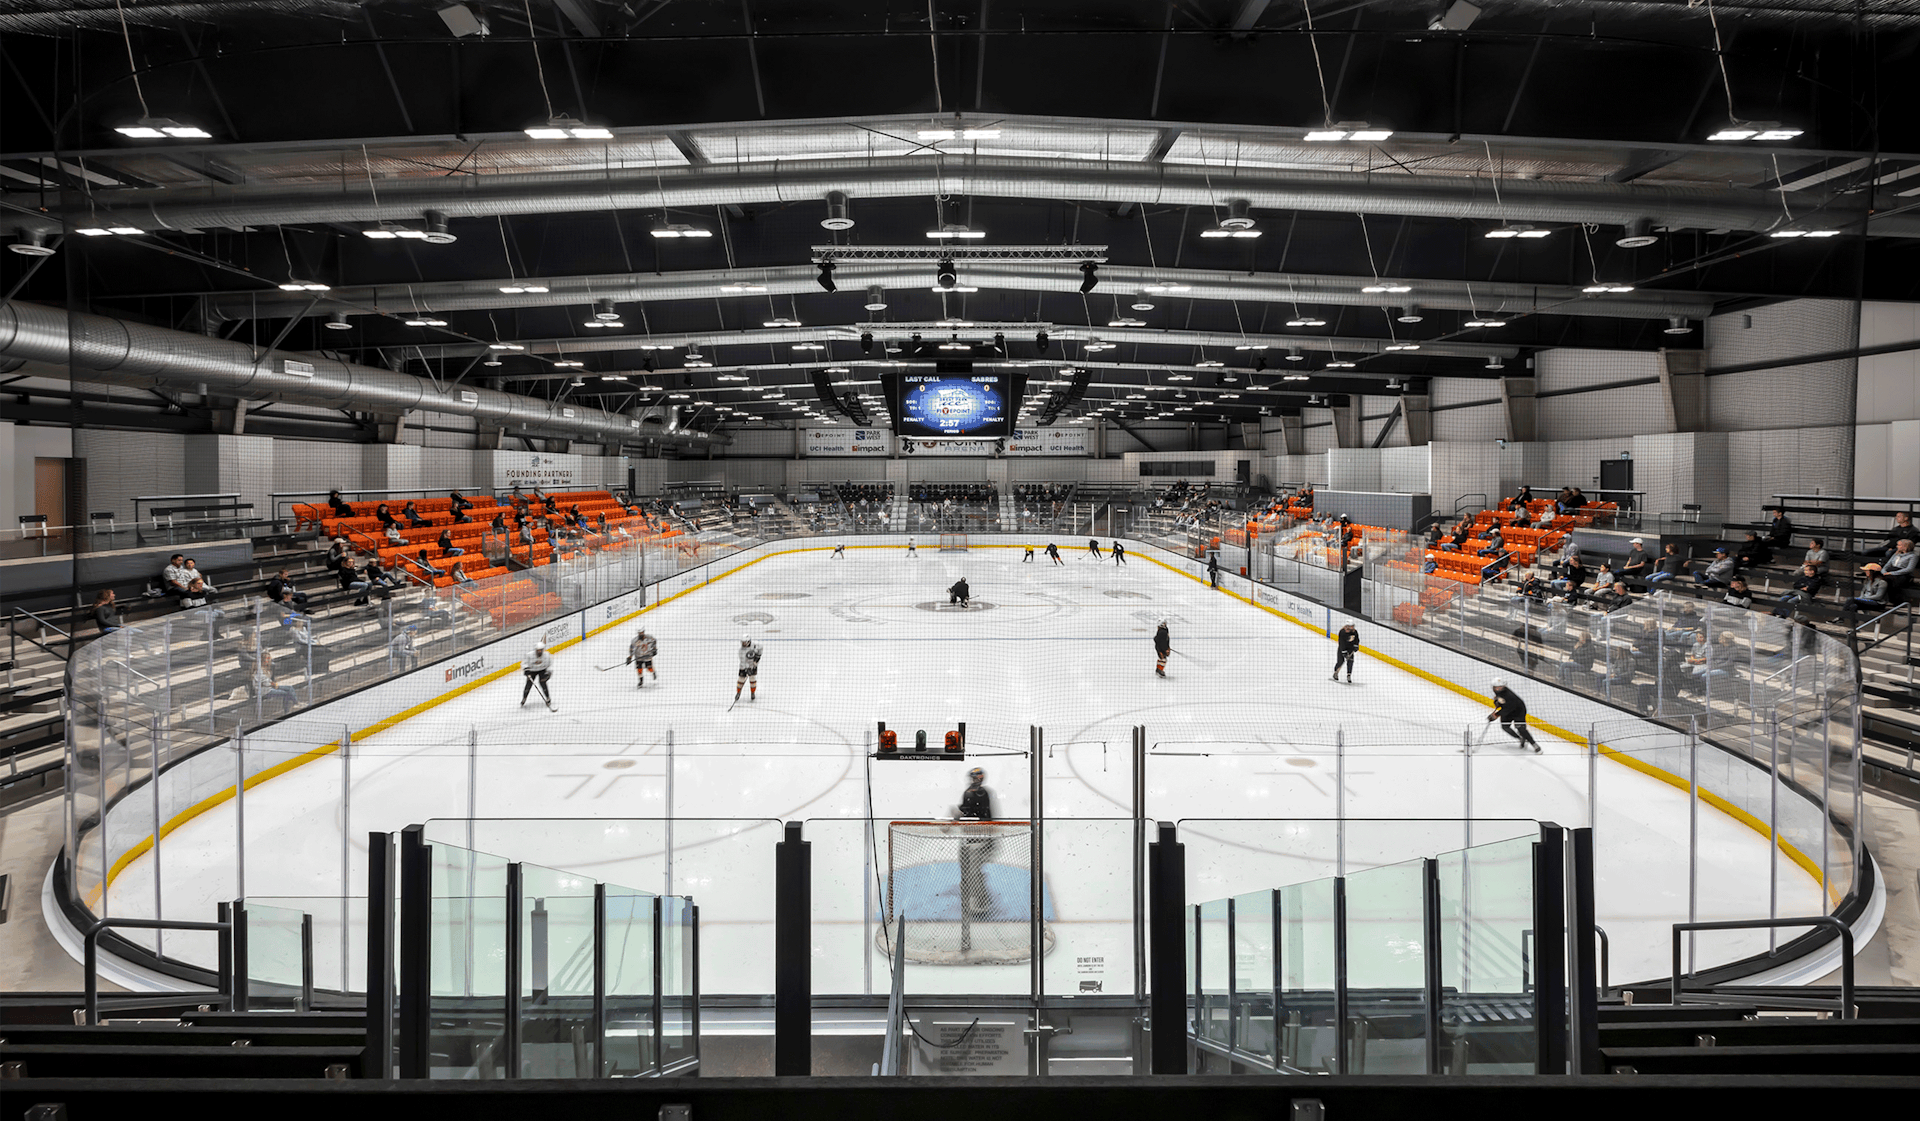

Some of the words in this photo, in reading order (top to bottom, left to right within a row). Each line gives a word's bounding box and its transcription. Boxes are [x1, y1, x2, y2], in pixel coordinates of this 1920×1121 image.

[984, 384, 990, 392] 0
[857, 444, 885, 453] impact
[1015, 444, 1042, 452] impact
[506, 469, 542, 478] FOUNDING
[544, 470, 573, 478] PARTNERS
[452, 655, 485, 680] impact
